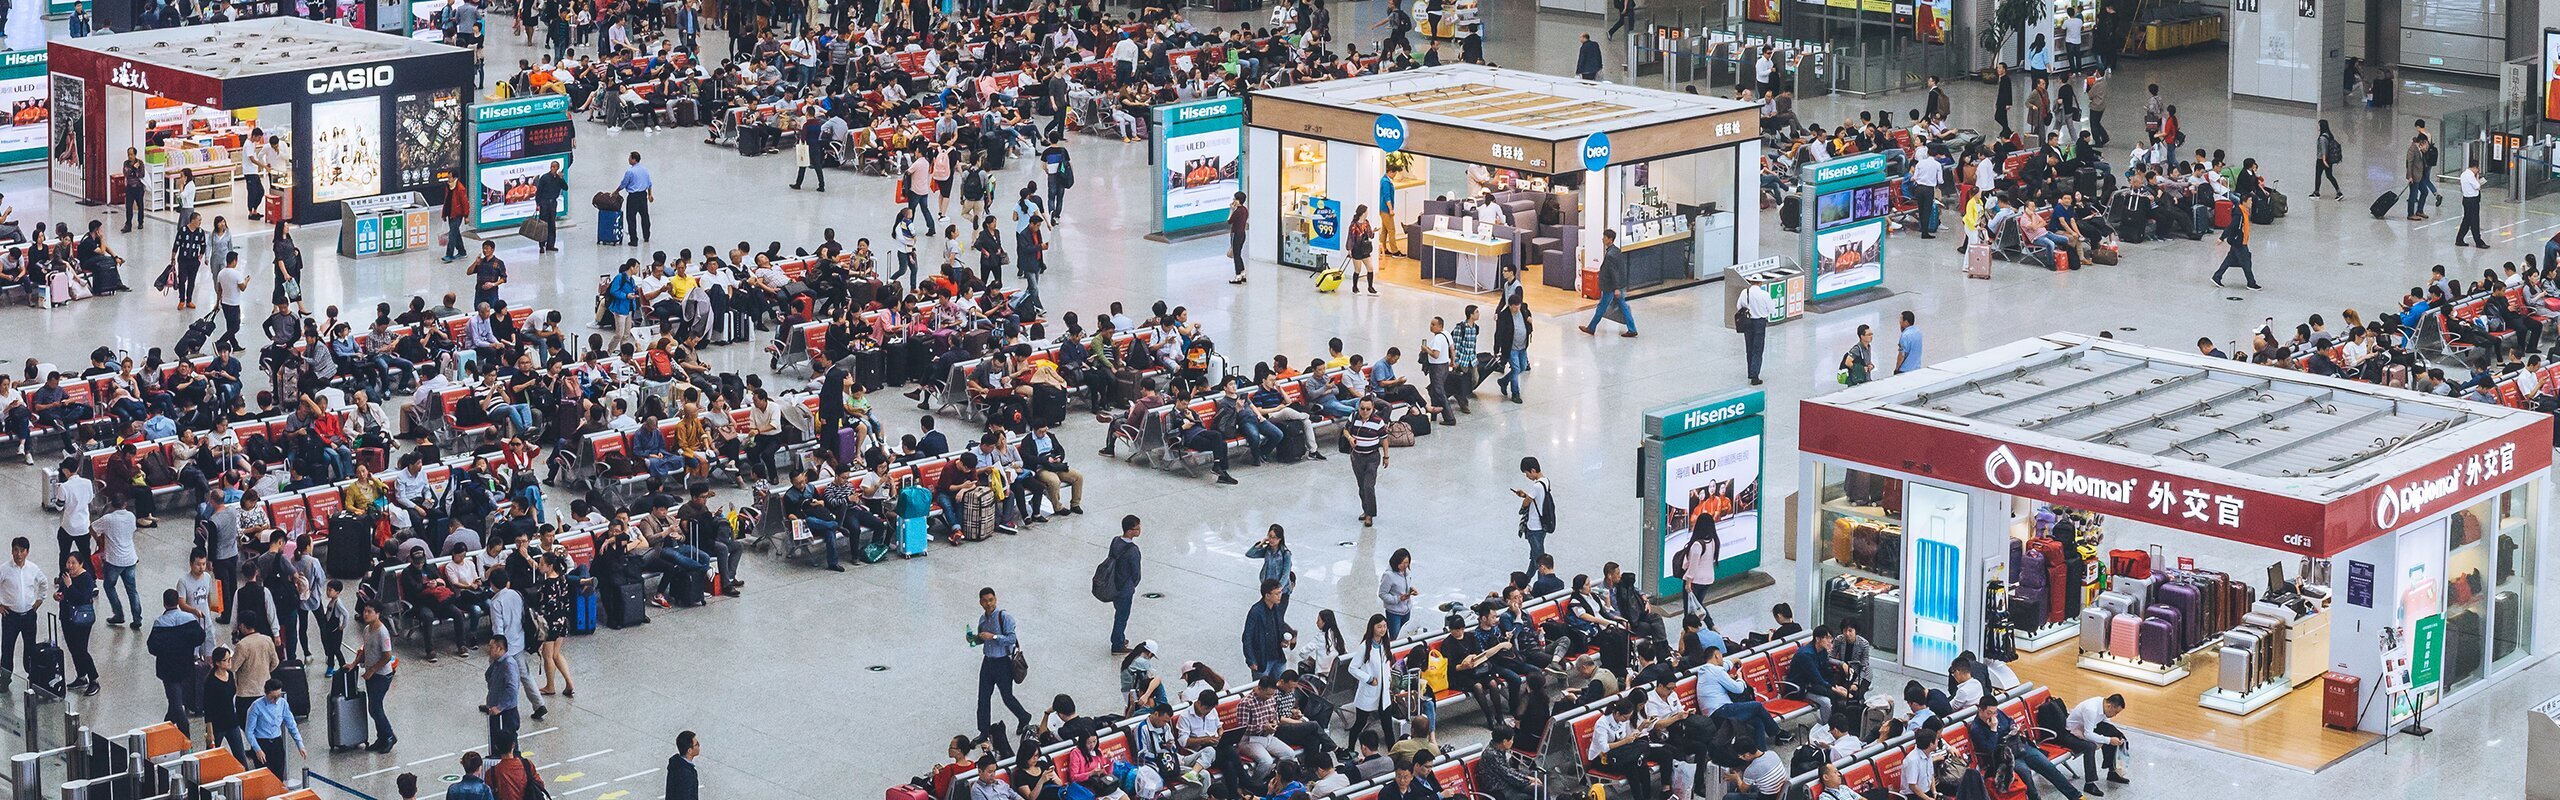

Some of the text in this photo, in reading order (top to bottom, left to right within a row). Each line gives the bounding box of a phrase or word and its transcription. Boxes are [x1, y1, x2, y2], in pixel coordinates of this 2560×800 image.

[6, 52, 47, 65] Hisens
[307, 65, 394, 95] CASIO
[397, 94, 416, 103] CASIO
[480, 105, 532, 120] Hisense
[1180, 104, 1227, 120] Hisense
[1375, 124, 1401, 140] breo
[1715, 120, 1741, 138] 倍轻松
[1186, 140, 1206, 151] ULED
[1491, 143, 1524, 161] 倍轻松
[1586, 145, 1609, 159] breo
[1817, 164, 1858, 181] Hisense
[1683, 402, 1746, 430] Hisense
[1691, 458, 1716, 475] ULED
[2400, 441, 2516, 514] Diplomat 外交官
[2024, 459, 2245, 529] Diplomat 外交官
[2283, 534, 2303, 547] cdf
